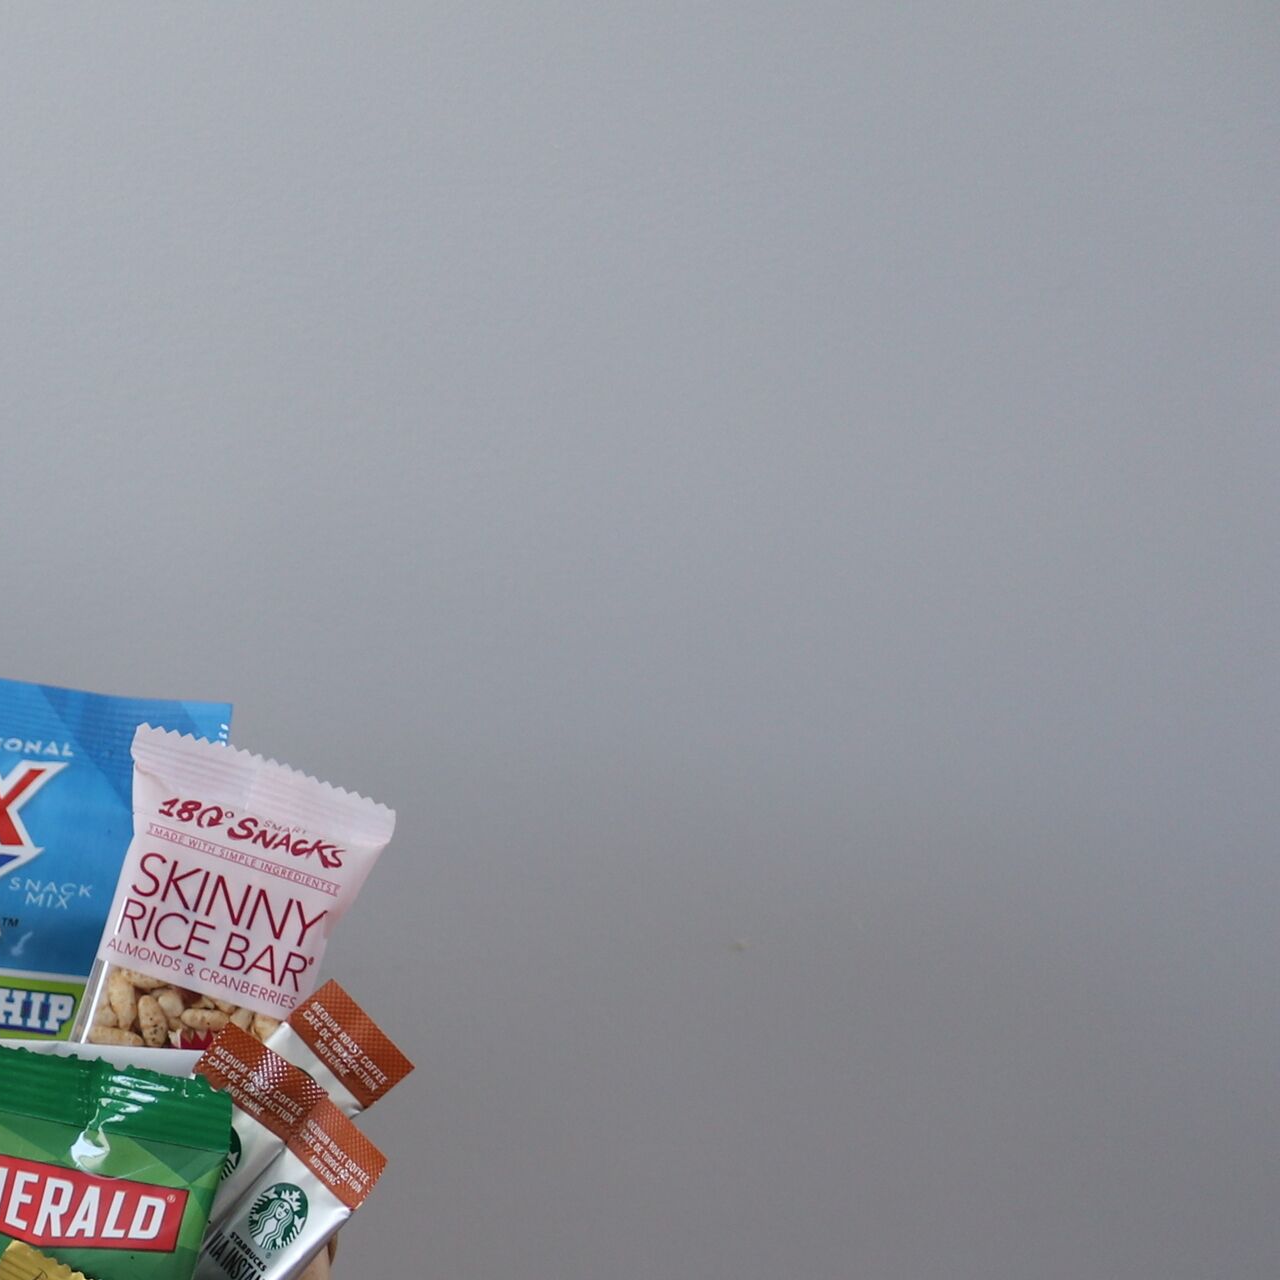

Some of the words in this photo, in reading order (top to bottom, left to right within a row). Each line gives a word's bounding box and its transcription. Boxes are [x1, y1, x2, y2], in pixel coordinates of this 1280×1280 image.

[152, 827, 185, 844] MADE
[188, 837, 216, 855] WITH
[218, 847, 257, 869] SIMPLE
[260, 860, 334, 895] INGREDIENTS
[227, 817, 347, 869] SNACKS
[8, 876, 94, 899] SNACK
[25, 892, 69, 910] MIX
[131, 852, 329, 948] SKINNY
[118, 898, 217, 962] RICE
[107, 938, 182, 973] ALMONDS
[183, 963, 196, 978] &
[198, 966, 298, 1010] CRANBERRIES
[310, 1001, 341, 1034] MEDIUM
[338, 1031, 364, 1058] ROAST
[360, 1055, 389, 1085] COFFEE
[319, 1027, 333, 1042] DE
[227, 1070, 241, 1084] DE
[314, 1039, 351, 1077] MOYENNE
[214, 1046, 249, 1074] MEDIUM
[272, 1089, 305, 1117] COFFEE
[224, 1083, 265, 1116] MOYENNE
[328, 1140, 348, 1163] ROAST
[344, 1158, 371, 1185] COFFEE
[204, 1231, 229, 1262] VIA
[229, 1231, 268, 1272] STARBUCKS
